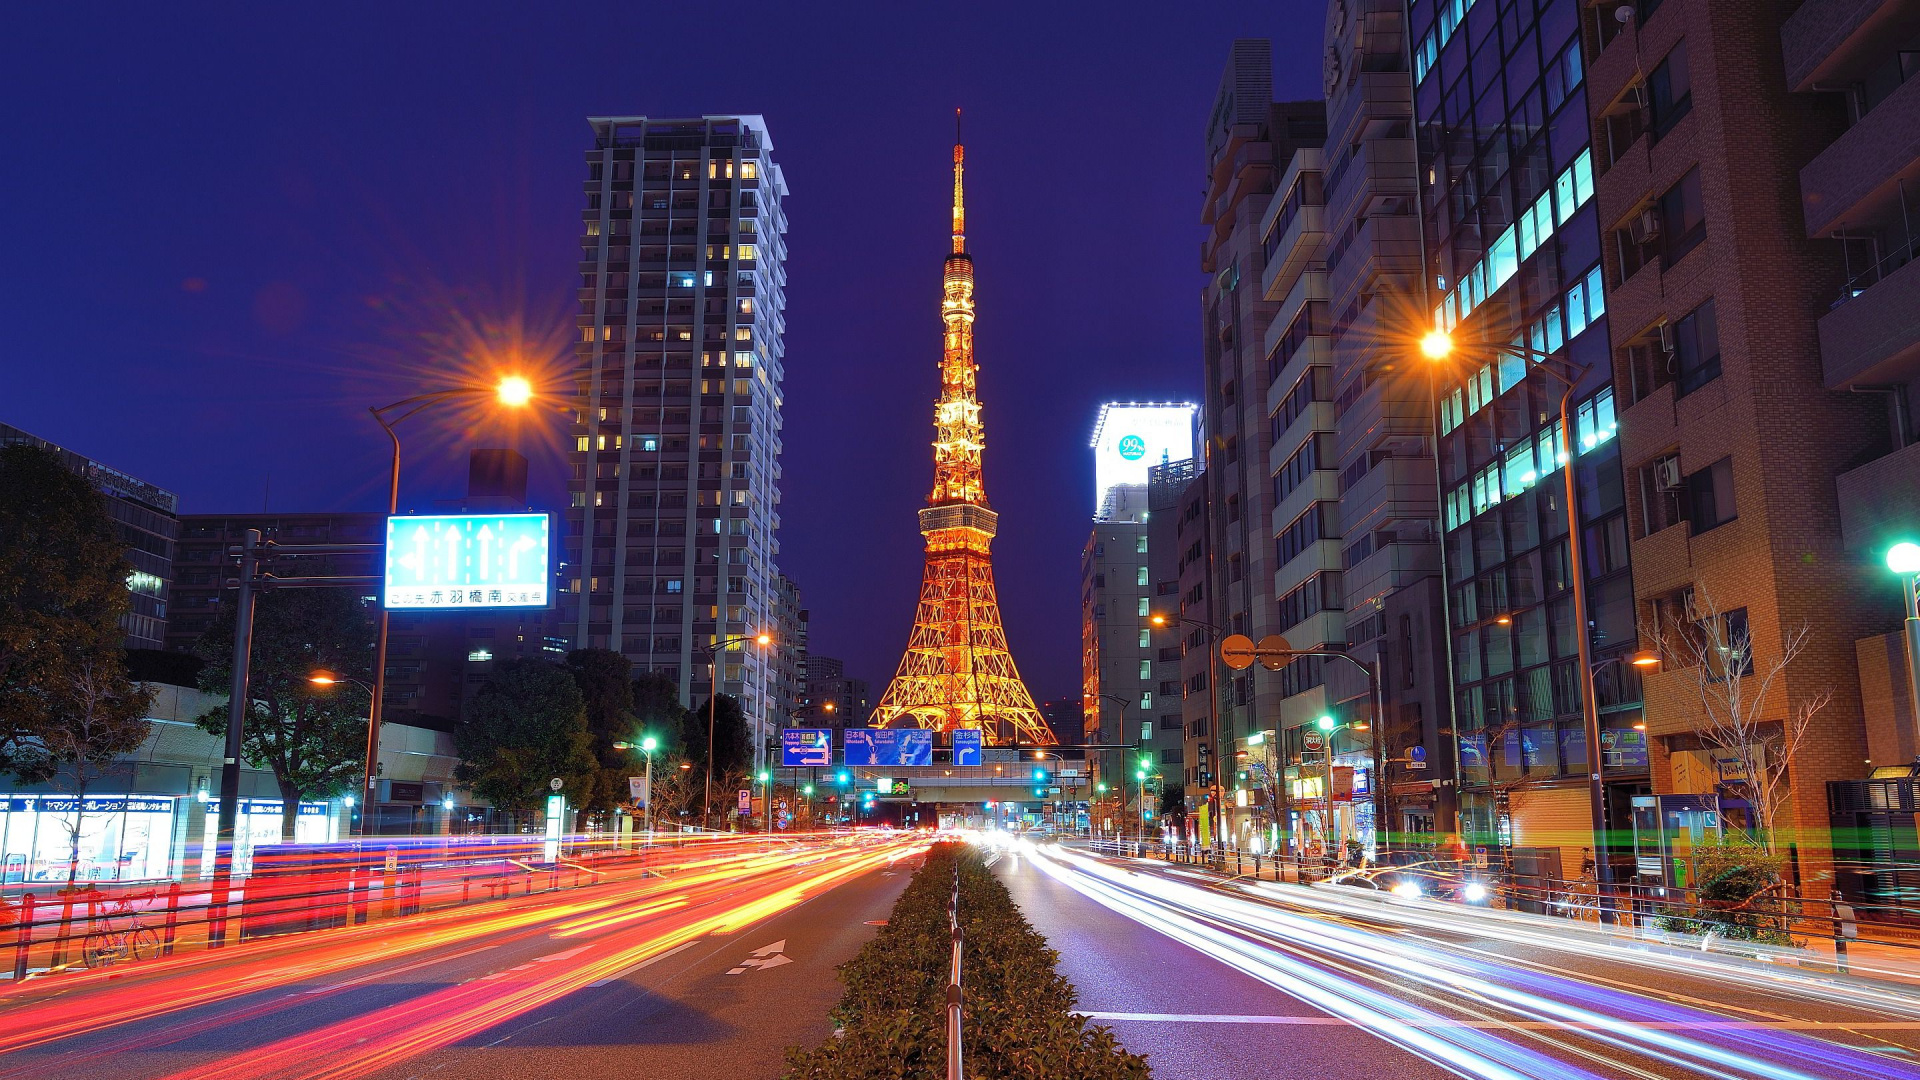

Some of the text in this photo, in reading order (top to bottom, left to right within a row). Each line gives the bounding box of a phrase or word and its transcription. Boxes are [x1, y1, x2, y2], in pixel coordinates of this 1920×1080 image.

[430, 589, 502, 604] 赤羽橋南
[507, 591, 542, 602] 交差点
[741, 792, 748, 800] P
